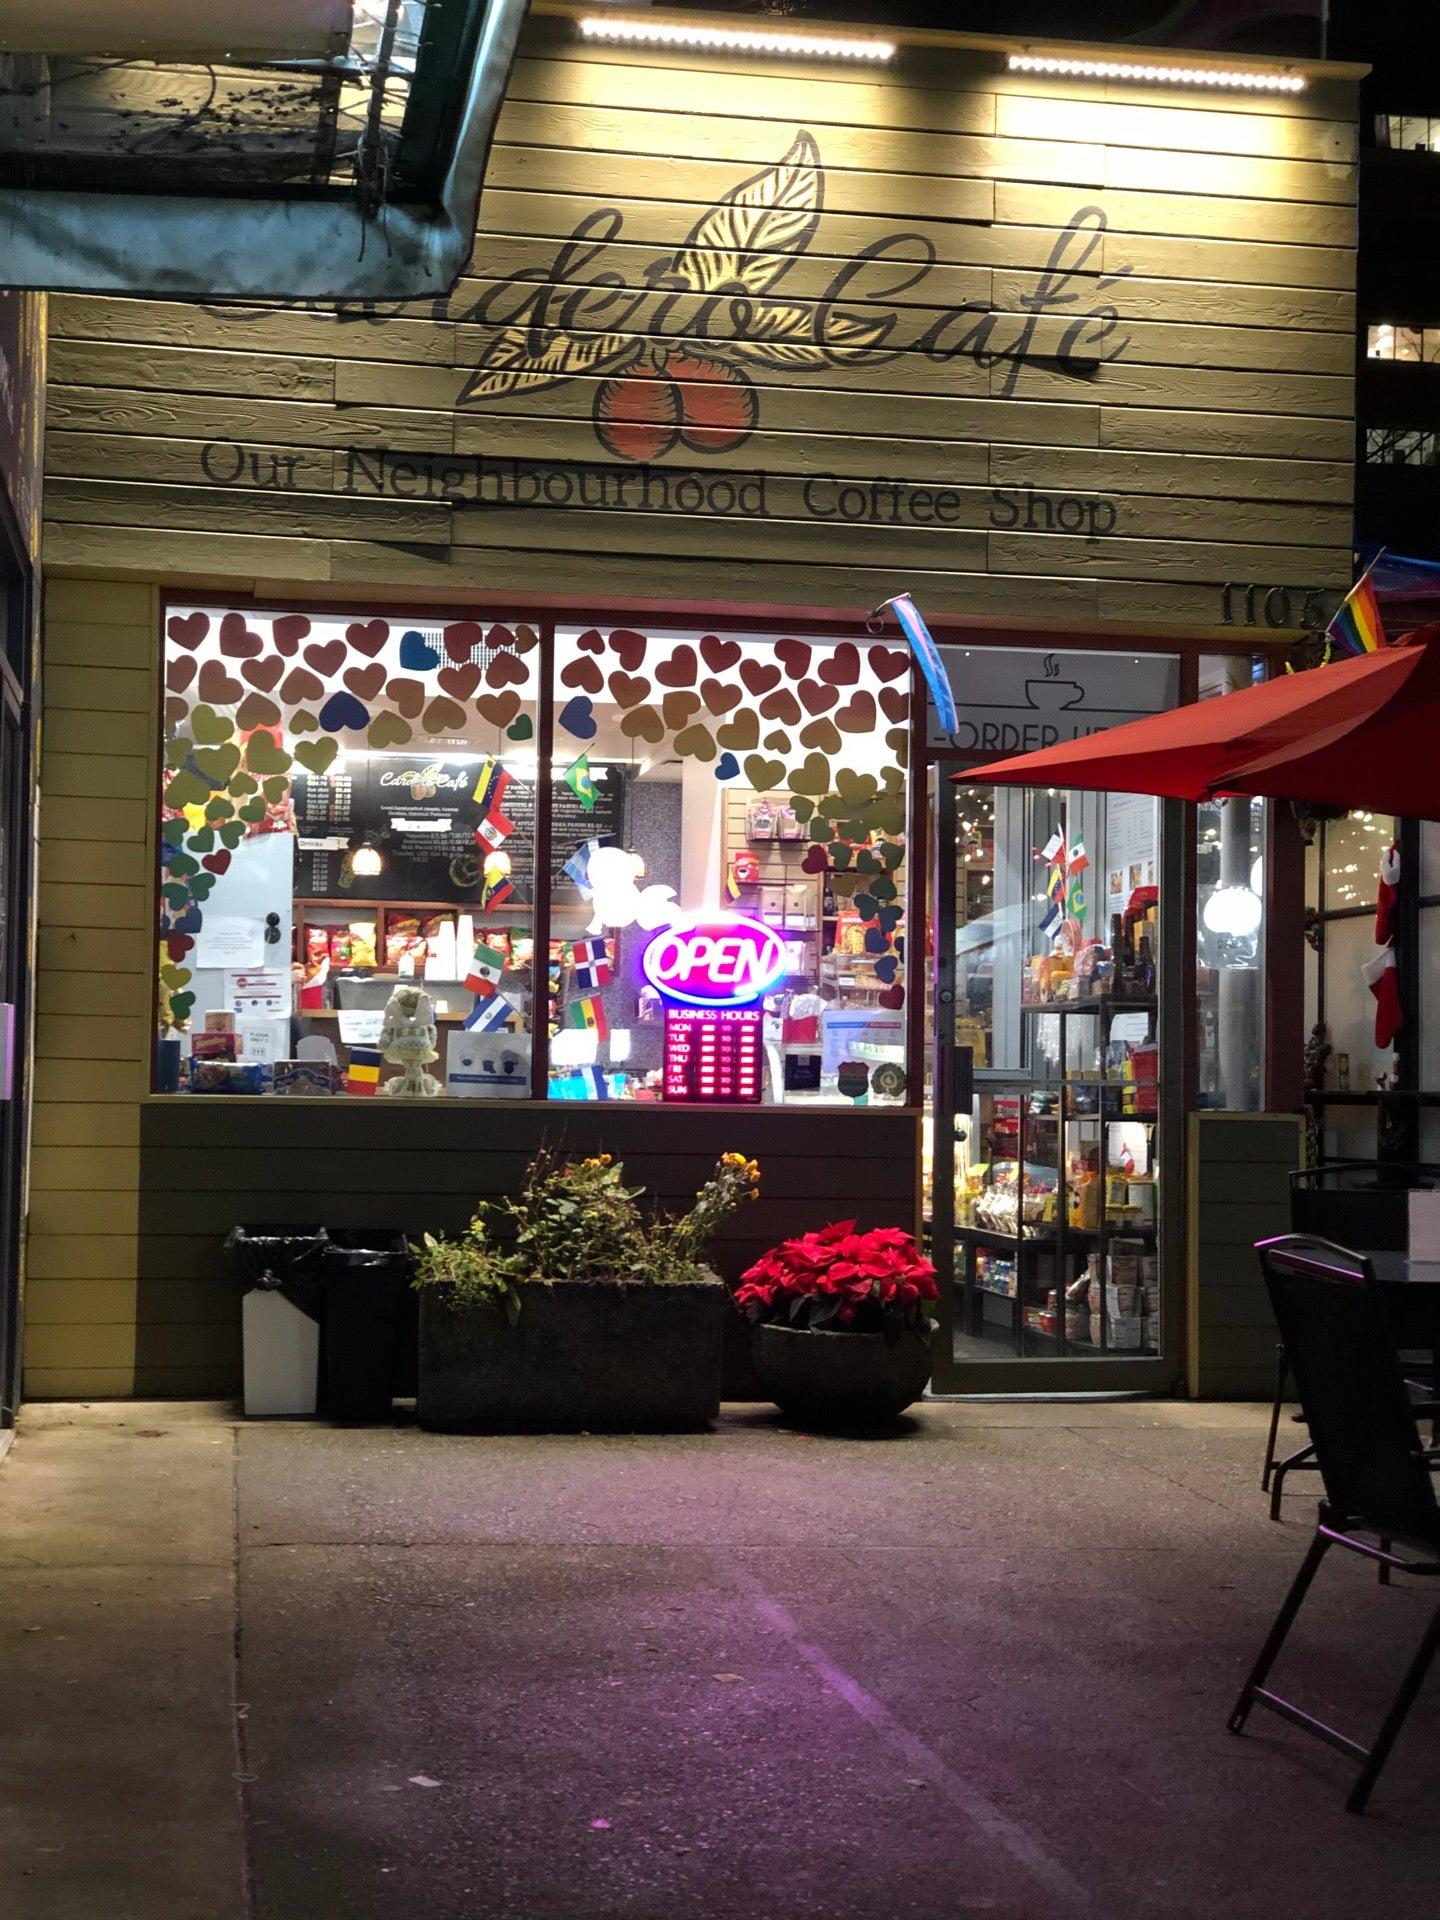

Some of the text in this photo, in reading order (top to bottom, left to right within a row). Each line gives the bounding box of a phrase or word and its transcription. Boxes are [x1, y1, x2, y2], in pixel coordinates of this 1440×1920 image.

[813, 206, 1133, 398] Café
[202, 436, 1116, 543] Our Neighbourhood Coffee Shop
[1222, 582, 1325, 629] 1105
[656, 934, 774, 983] OPEN
[668, 1009, 760, 1021] BUSINESS HOURS
[669, 1023, 692, 1031] MON
[669, 1033, 686, 1042] TUE
[669, 1044, 690, 1052] WED
[669, 1054, 688, 1062] THU
[668, 1075, 684, 1083] SAT
[667, 1086, 688, 1094] SUN
